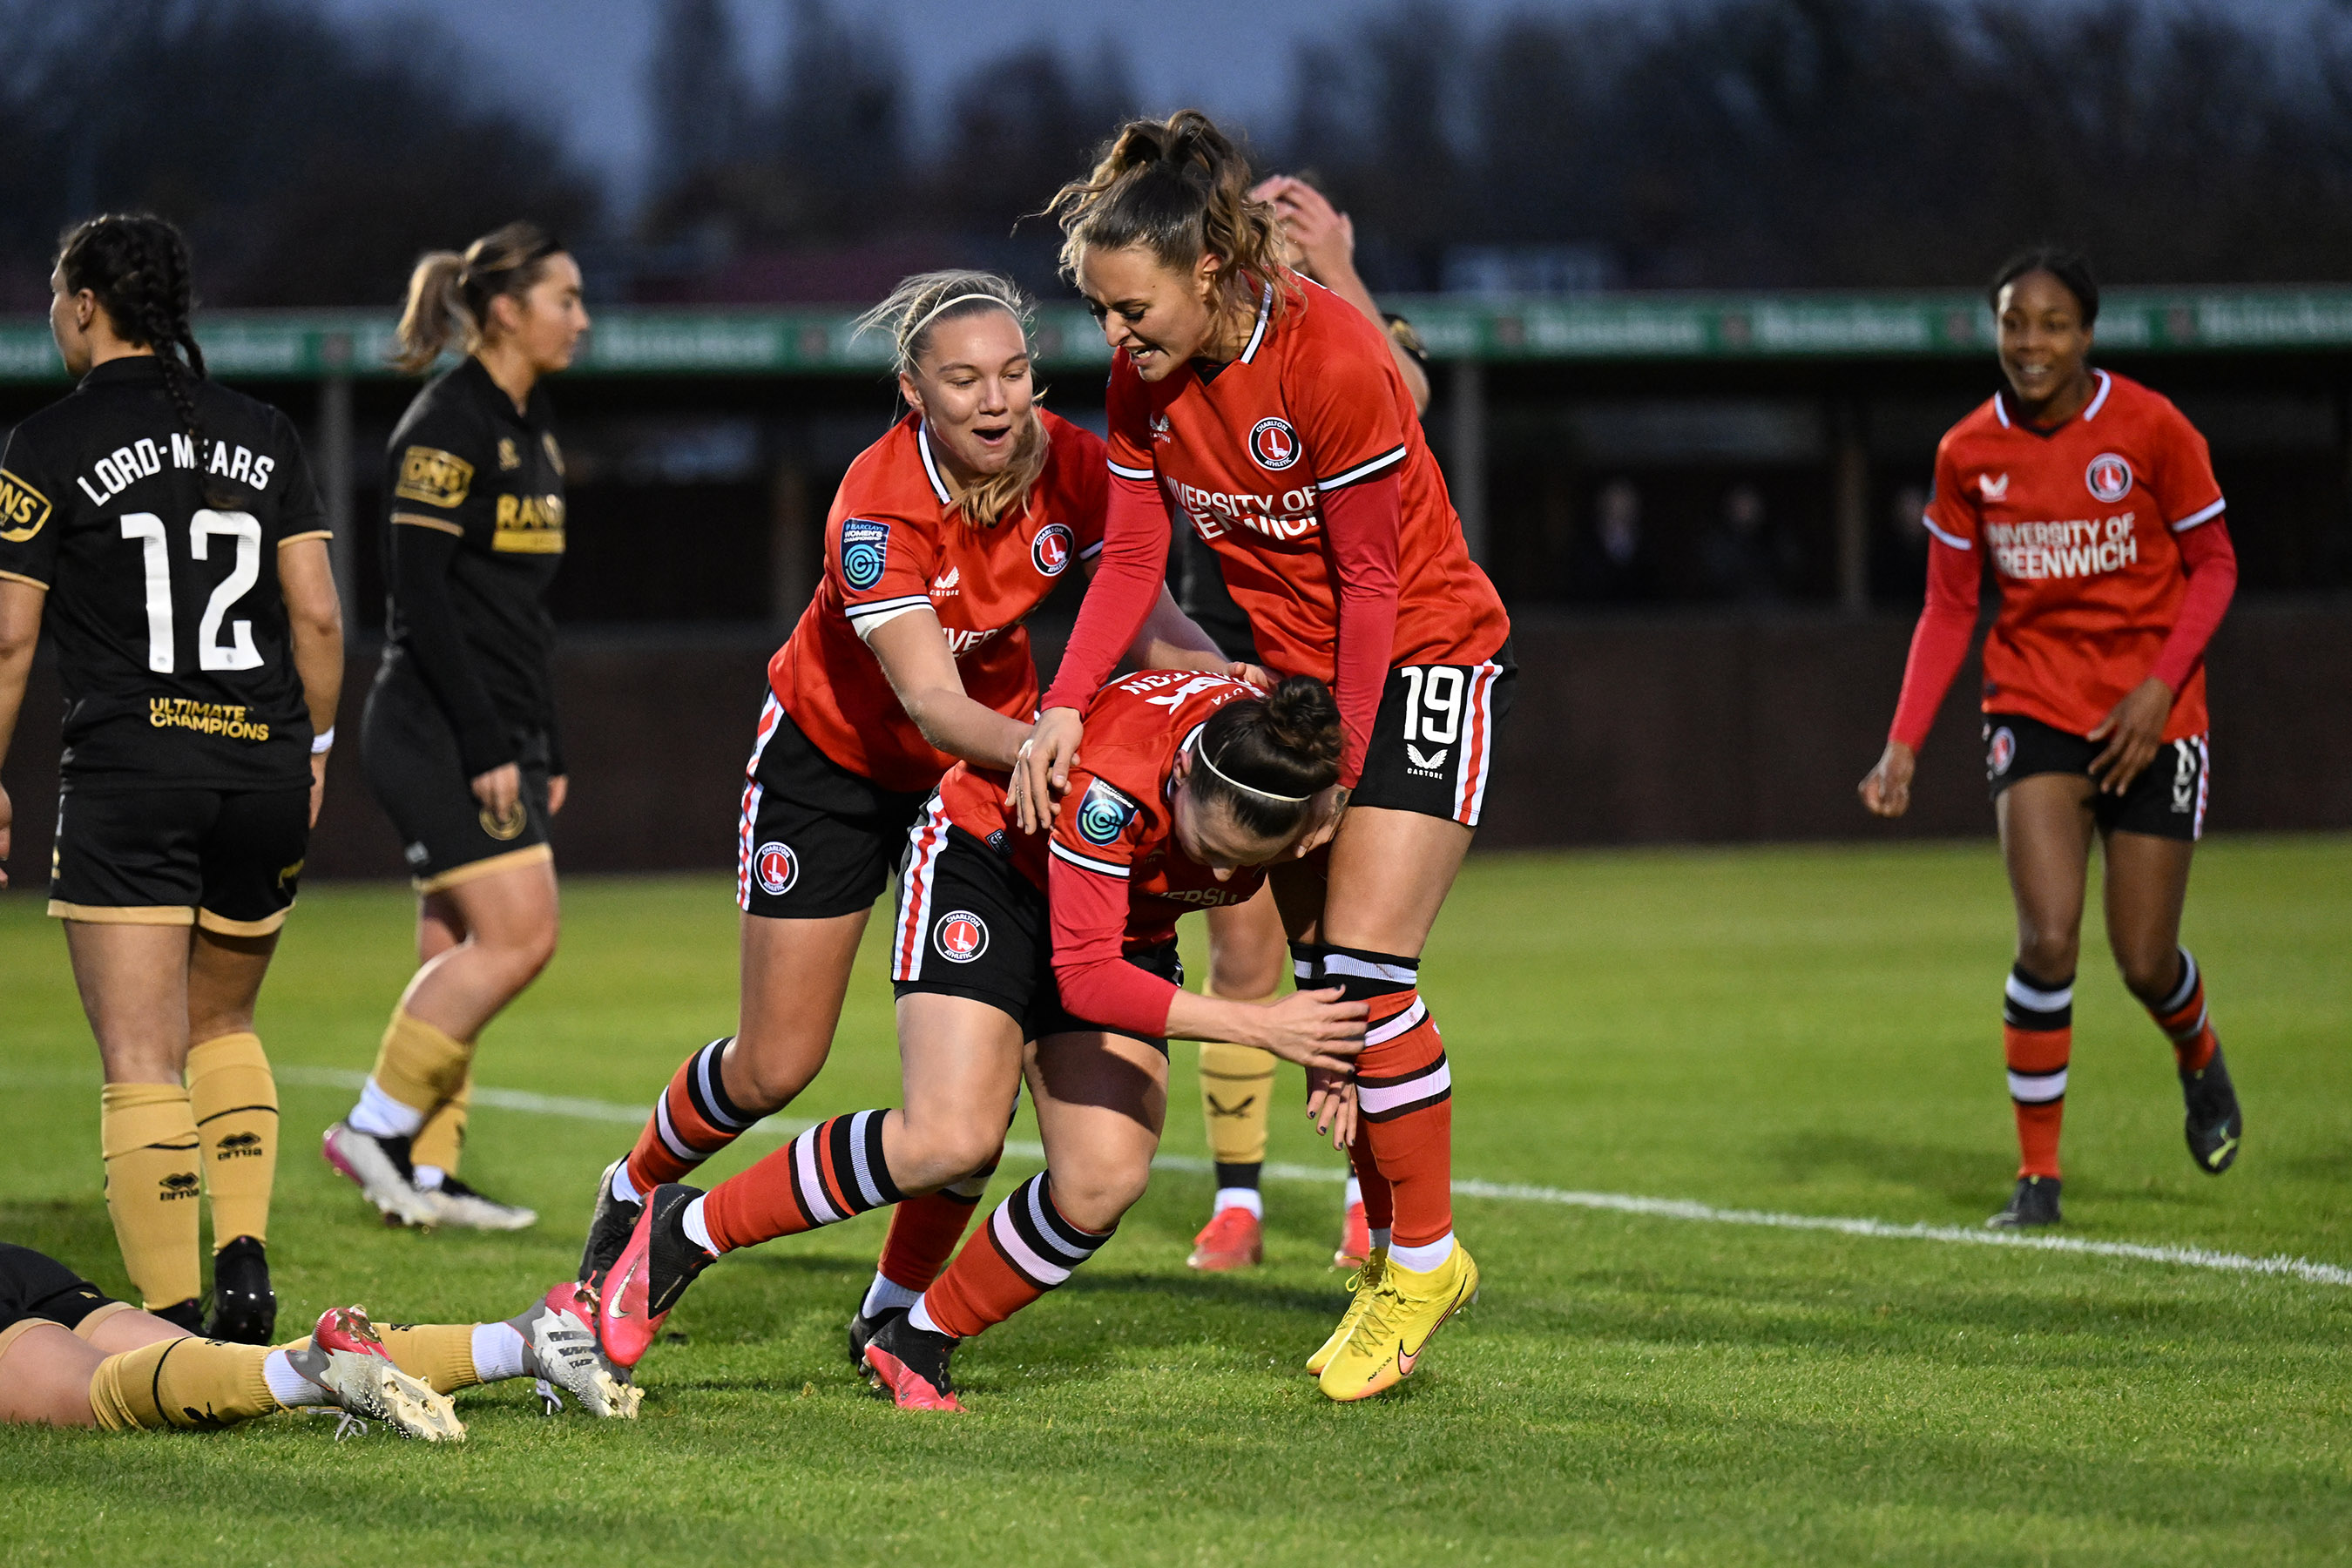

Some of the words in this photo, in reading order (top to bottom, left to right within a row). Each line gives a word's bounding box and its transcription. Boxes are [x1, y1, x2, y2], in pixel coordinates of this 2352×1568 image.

[1256, 421, 1288, 432] CHARLTON
[1264, 457, 1292, 467] ATHLETIC
[1282, 486, 1316, 511] OF
[2105, 511, 2135, 540] OF
[1037, 527, 1064, 546] CHARLTON
[120, 509, 265, 673] 12
[150, 698, 247, 722] ULTIMATE
[1402, 666, 1464, 744] 19
[150, 712, 269, 740] CHAMPIONS
[1407, 767, 1443, 780] CASTORE
[761, 845, 790, 858] CHARLTON
[946, 914, 980, 928] CHARLTON
[944, 950, 973, 959] ATHLETIC
